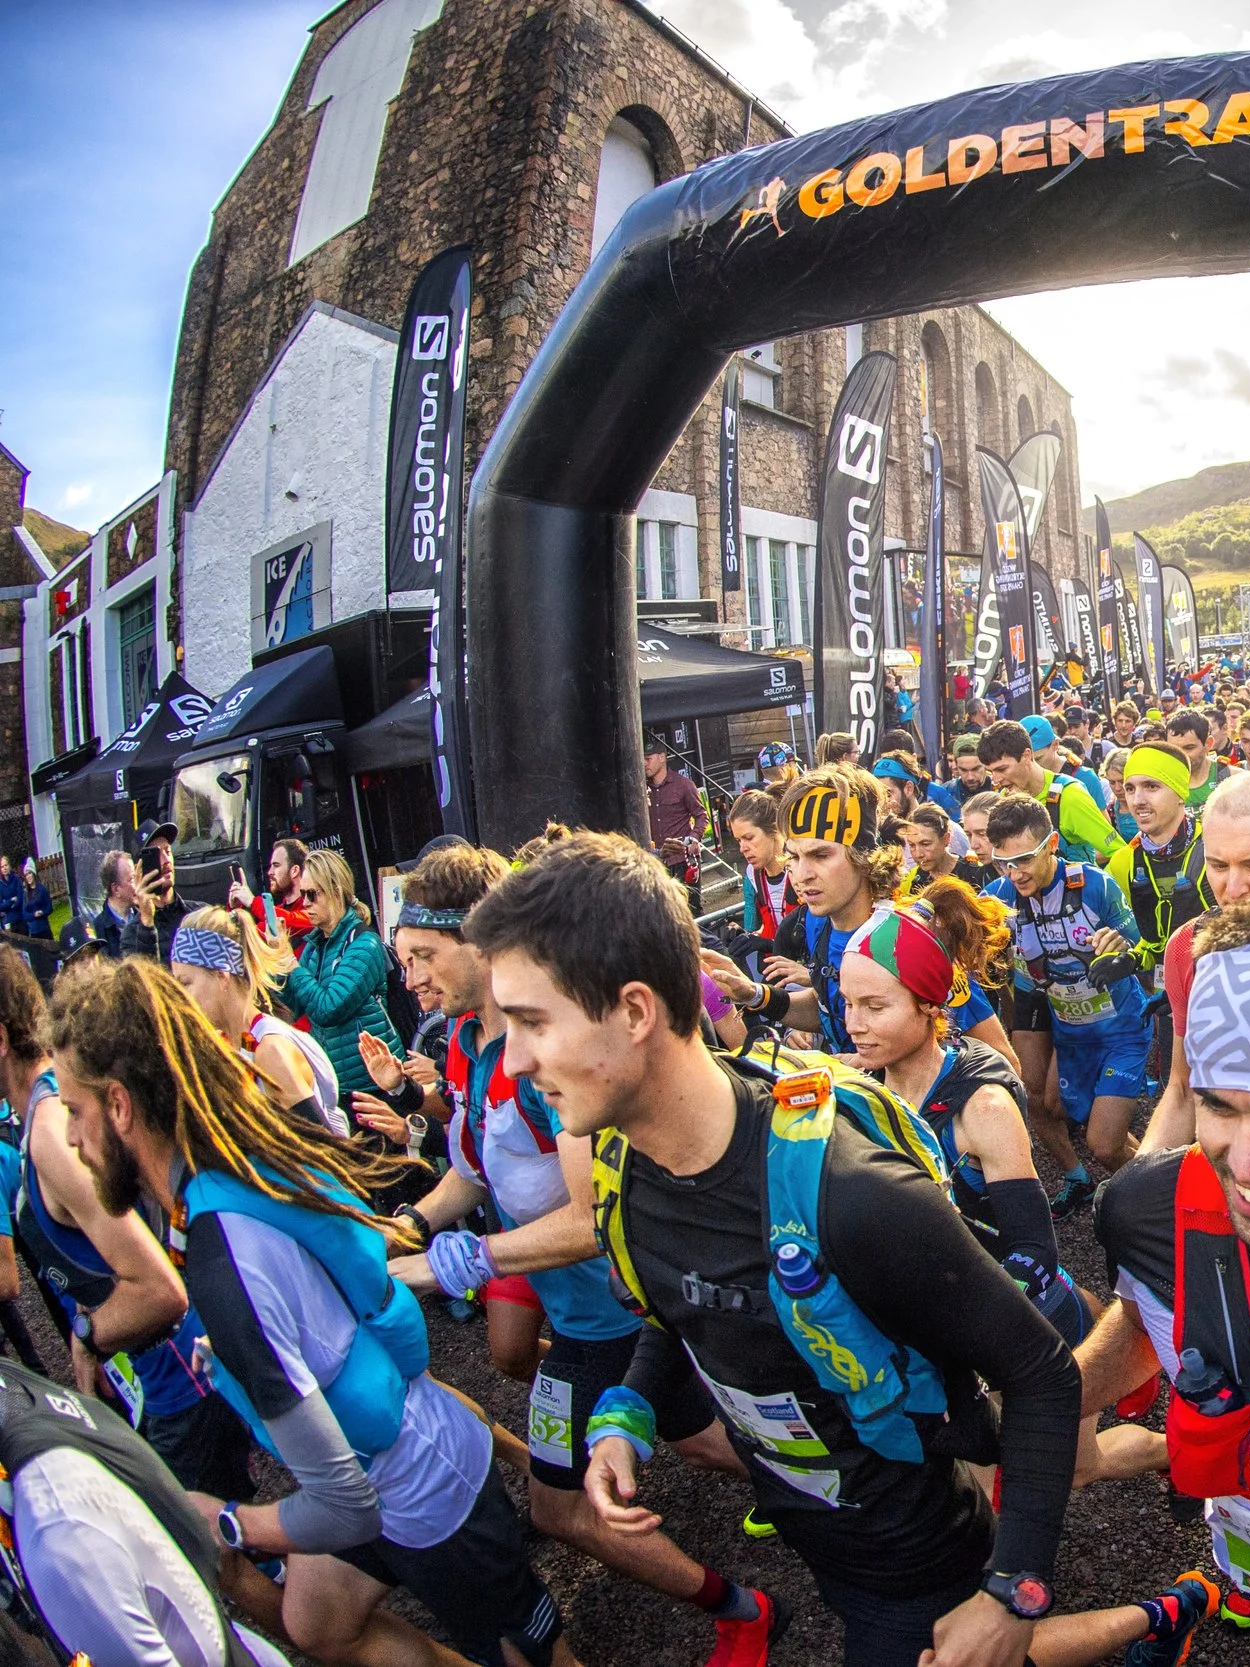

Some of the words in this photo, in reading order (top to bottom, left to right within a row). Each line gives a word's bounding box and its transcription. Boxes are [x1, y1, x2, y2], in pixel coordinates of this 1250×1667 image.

[265, 554, 287, 585] ICE
[1060, 1000, 1094, 1017] 280
[758, 1404, 794, 1415] Scotland
[529, 1404, 568, 1448] 52
